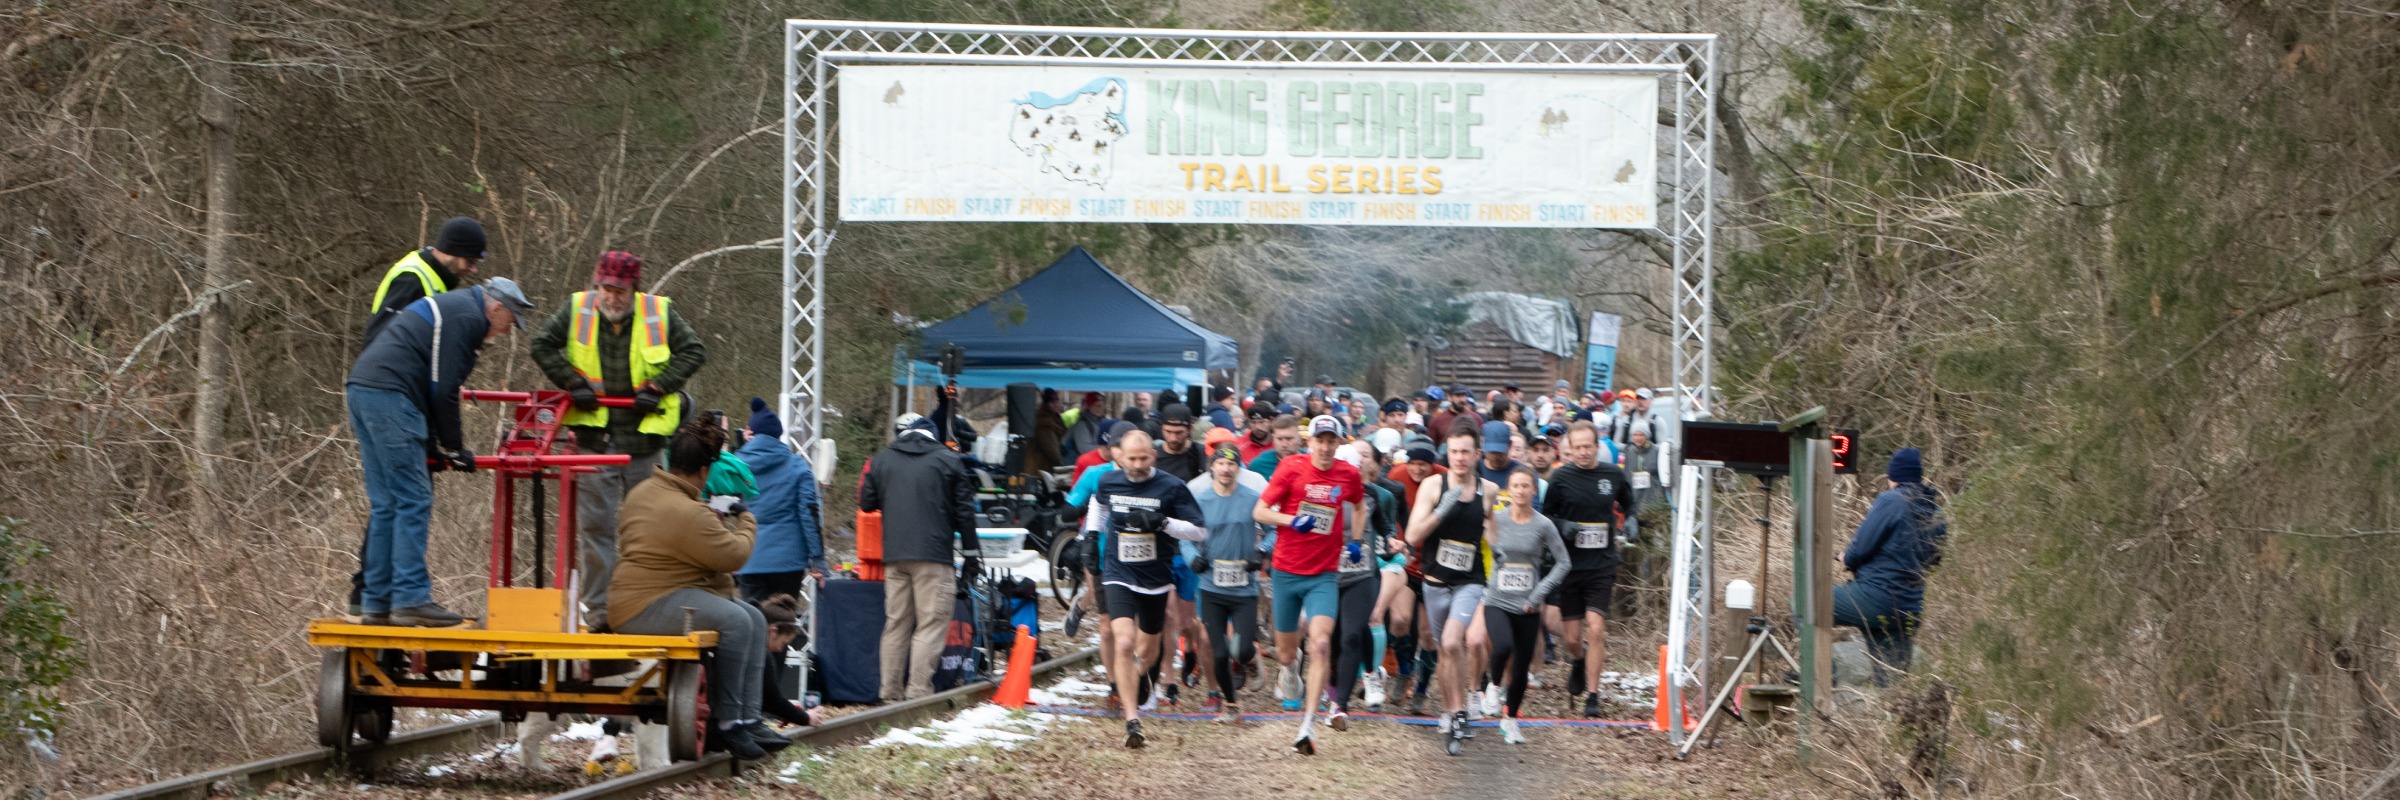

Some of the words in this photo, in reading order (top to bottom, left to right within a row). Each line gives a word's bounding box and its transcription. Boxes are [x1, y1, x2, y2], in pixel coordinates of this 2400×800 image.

[1146, 79, 1268, 156] KING
[1287, 80, 1485, 159] GEORGE
[1179, 163, 1292, 193] TRAIL
[1306, 165, 1444, 195] SERIES
[849, 198, 897, 216] START
[904, 198, 957, 217] FINISH
[963, 199, 1012, 217] START
[1019, 199, 1071, 217] FINISH
[1079, 199, 1127, 217] START
[1133, 199, 1186, 218] FINISH
[1194, 200, 1242, 218] START
[1249, 201, 1302, 219] FINISH
[1309, 201, 1357, 219] START
[1363, 202, 1416, 220] FINISH
[1423, 203, 1471, 221] START
[1479, 203, 1532, 222] FINISH
[1538, 204, 1586, 222] START
[1593, 205, 1647, 223] FINISH
